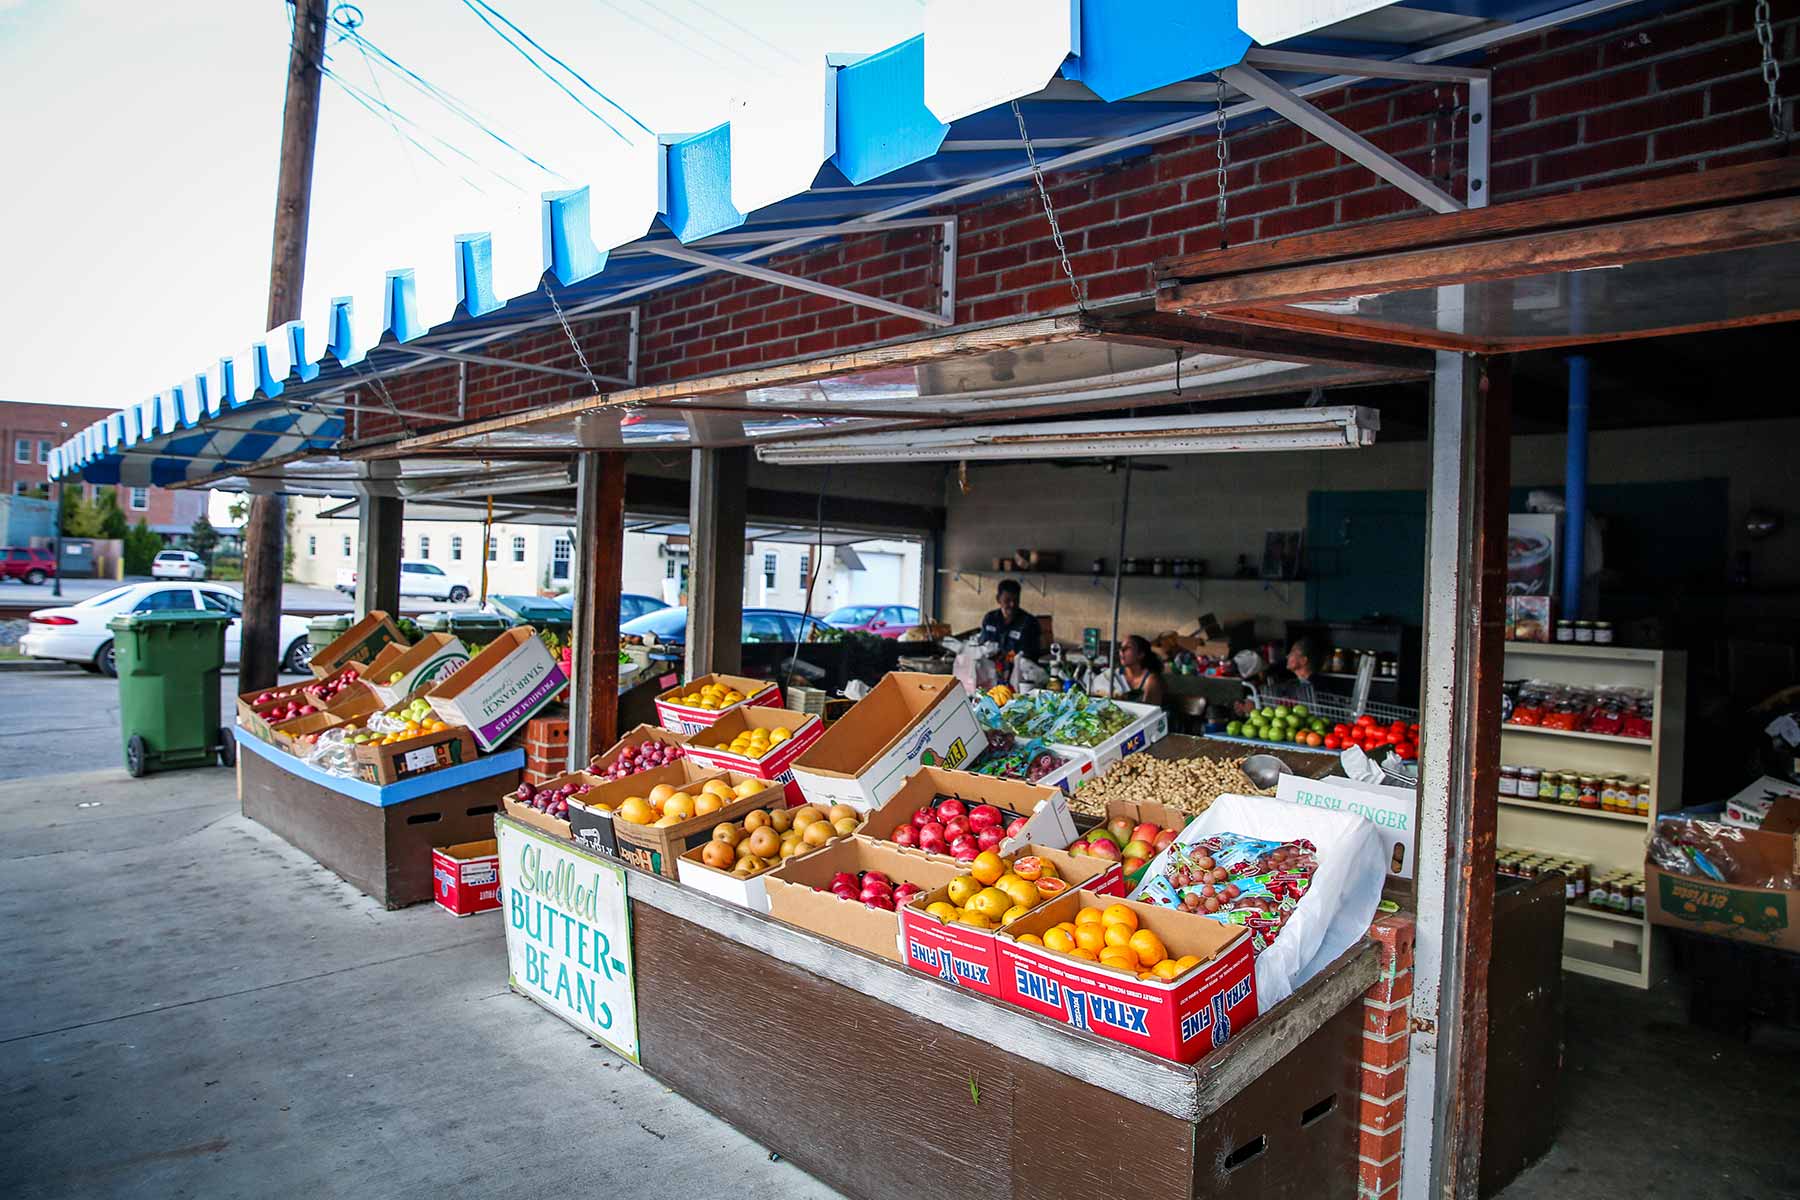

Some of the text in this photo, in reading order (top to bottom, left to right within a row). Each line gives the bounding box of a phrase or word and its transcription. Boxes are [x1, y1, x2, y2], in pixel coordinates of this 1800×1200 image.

[518, 663, 544, 691] STARR
[482, 686, 518, 717] RANCH
[495, 679, 555, 732] PREMIUM APPLES
[1295, 790, 1408, 831] FRESH GINGER
[519, 842, 600, 924] Shelled
[511, 887, 626, 982] BUTTER-
[911, 942, 937, 966] FINE
[954, 959, 988, 984] X-TRA
[1017, 969, 1060, 1005] FINE
[1226, 975, 1252, 1010] X-TRA
[1090, 995, 1148, 1034] X-TRA
[1182, 1005, 1211, 1041] FINE
